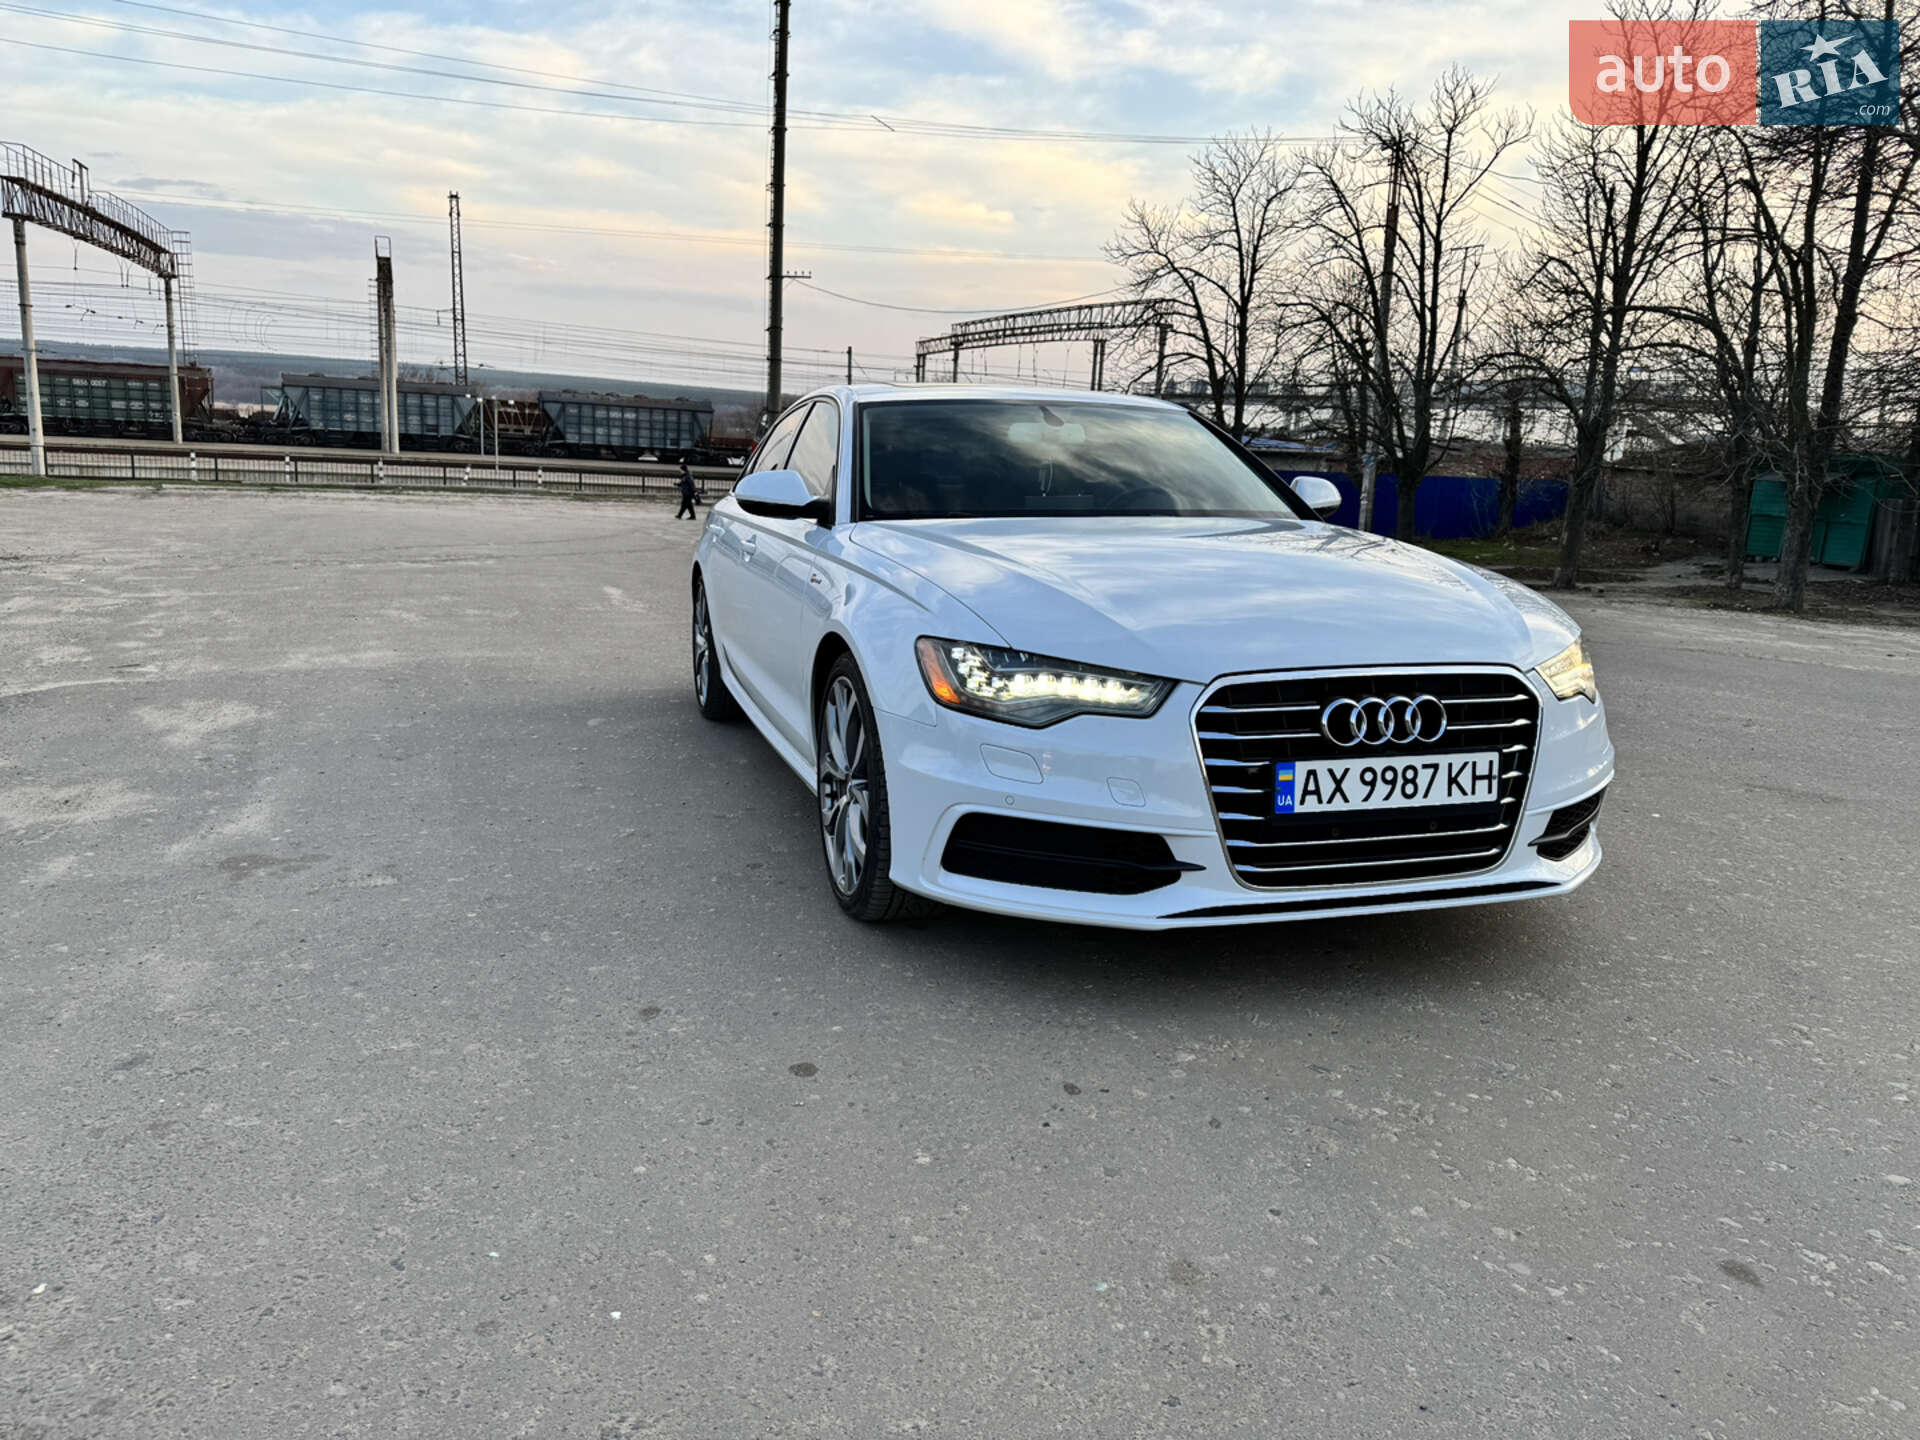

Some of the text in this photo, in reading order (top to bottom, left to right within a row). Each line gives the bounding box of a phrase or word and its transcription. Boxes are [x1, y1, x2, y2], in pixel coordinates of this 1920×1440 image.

[1299, 760, 1494, 805] AX 9987 KH
[1278, 795, 1293, 806] UA
